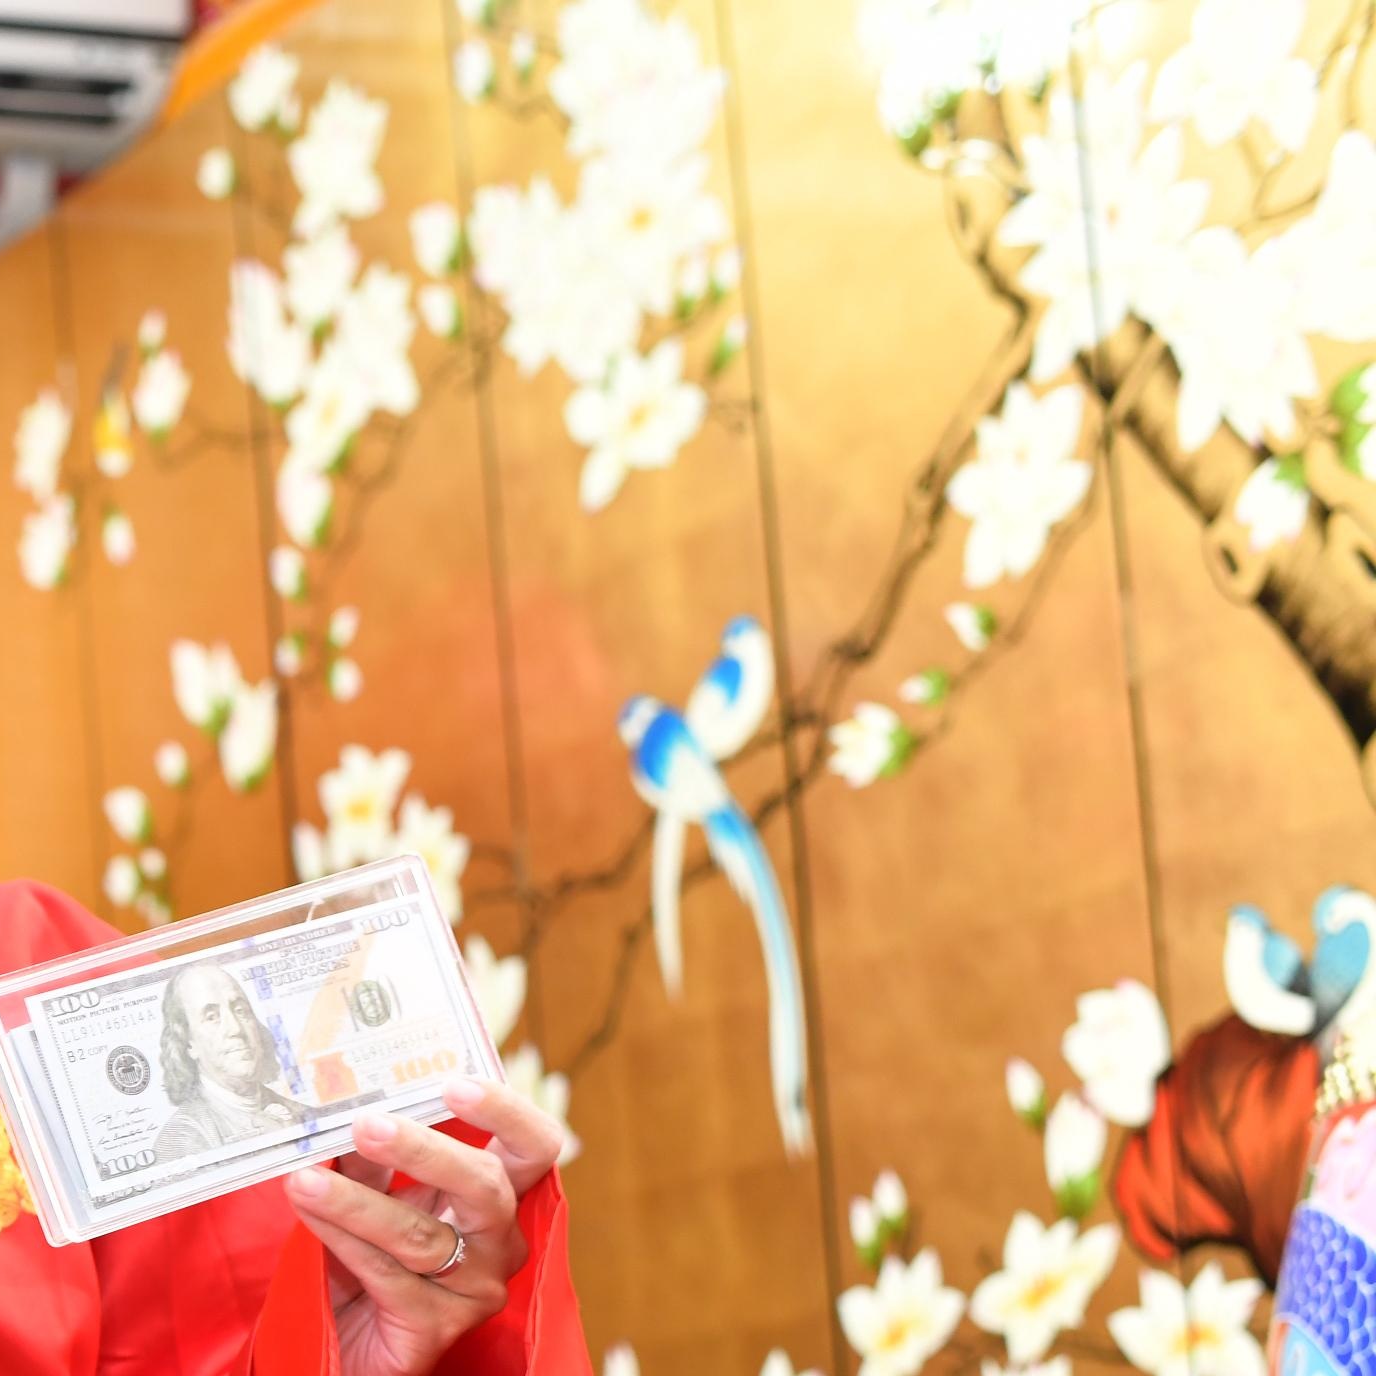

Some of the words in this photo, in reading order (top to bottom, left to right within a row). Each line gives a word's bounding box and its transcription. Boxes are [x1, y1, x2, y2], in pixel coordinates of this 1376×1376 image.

[51, 989, 101, 1018] 100
[391, 1048, 458, 1086] 100
[102, 1149, 156, 1177] 100
